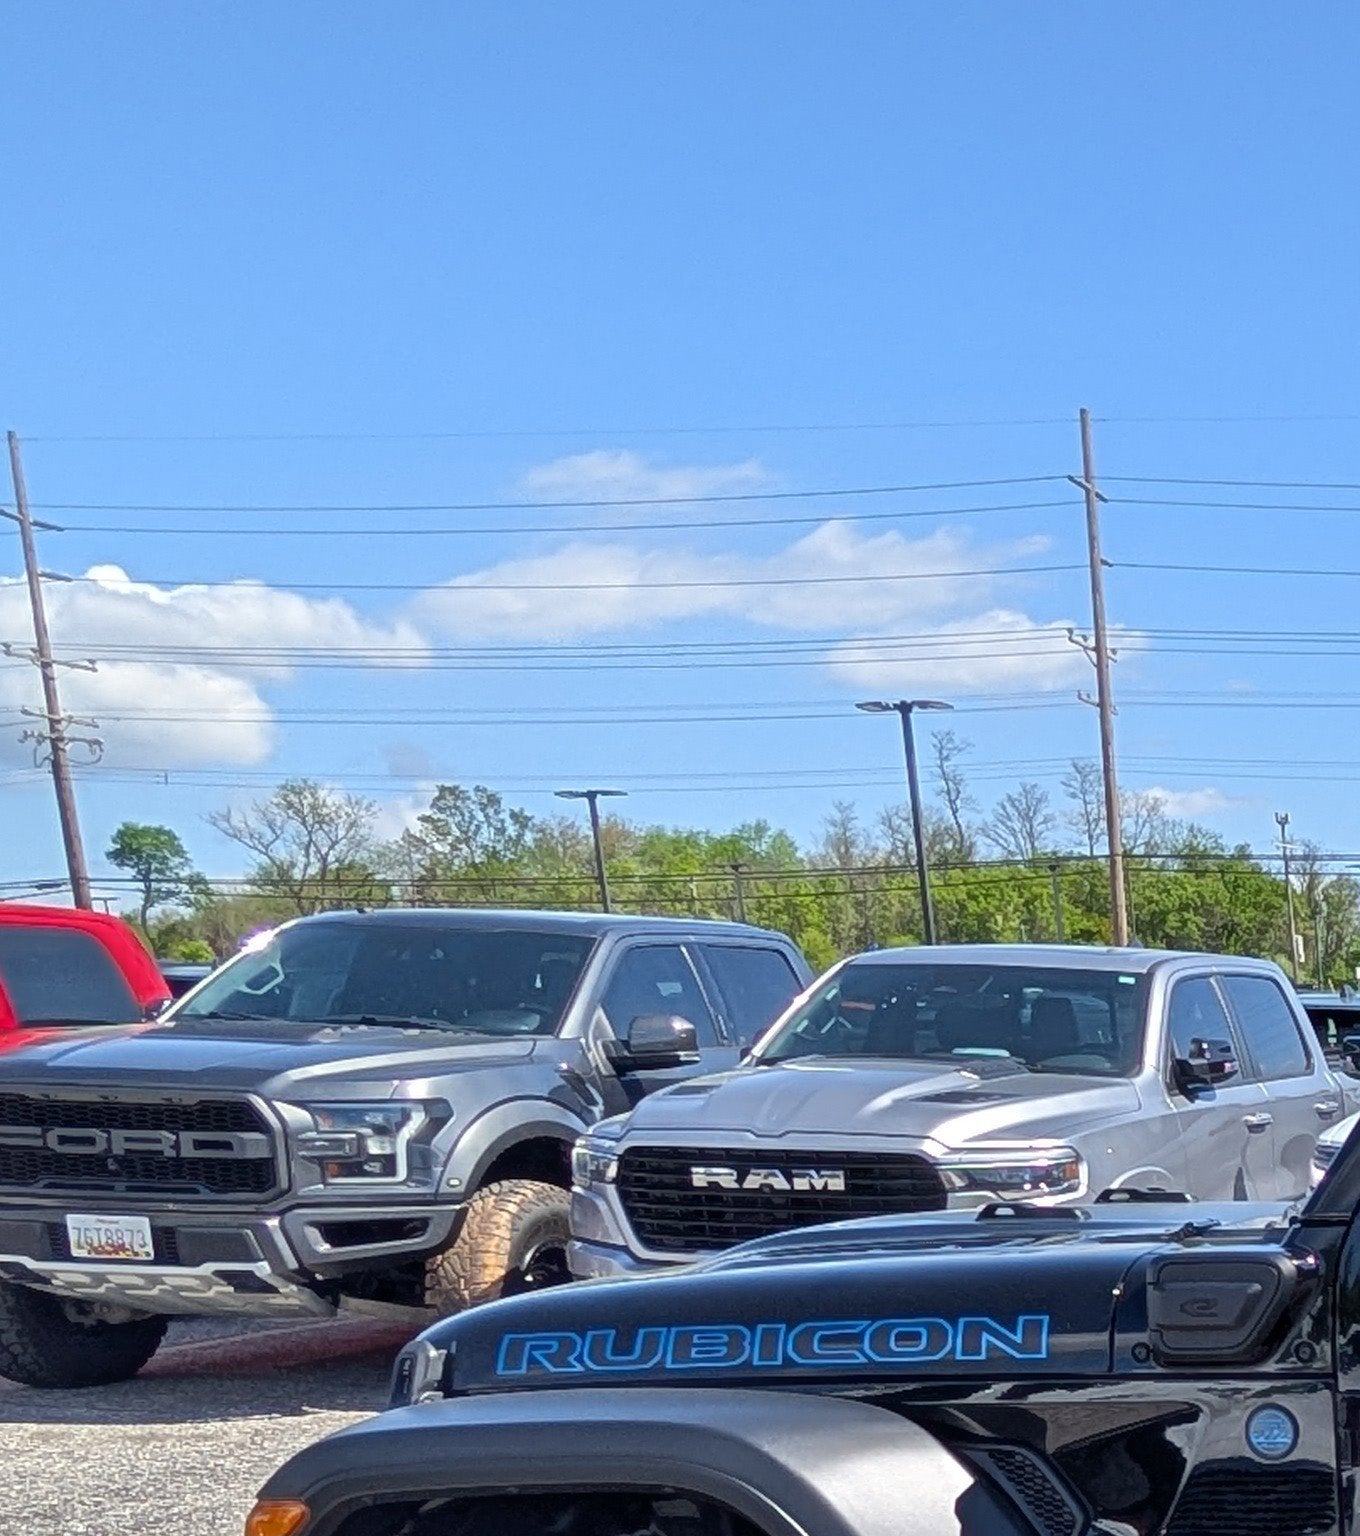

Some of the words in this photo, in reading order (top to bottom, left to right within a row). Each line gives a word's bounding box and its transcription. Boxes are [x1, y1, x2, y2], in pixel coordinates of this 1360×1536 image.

[0, 1126, 243, 1158] FORD
[690, 1167, 845, 1191] RAM
[496, 1315, 1049, 1375] RUBICON
